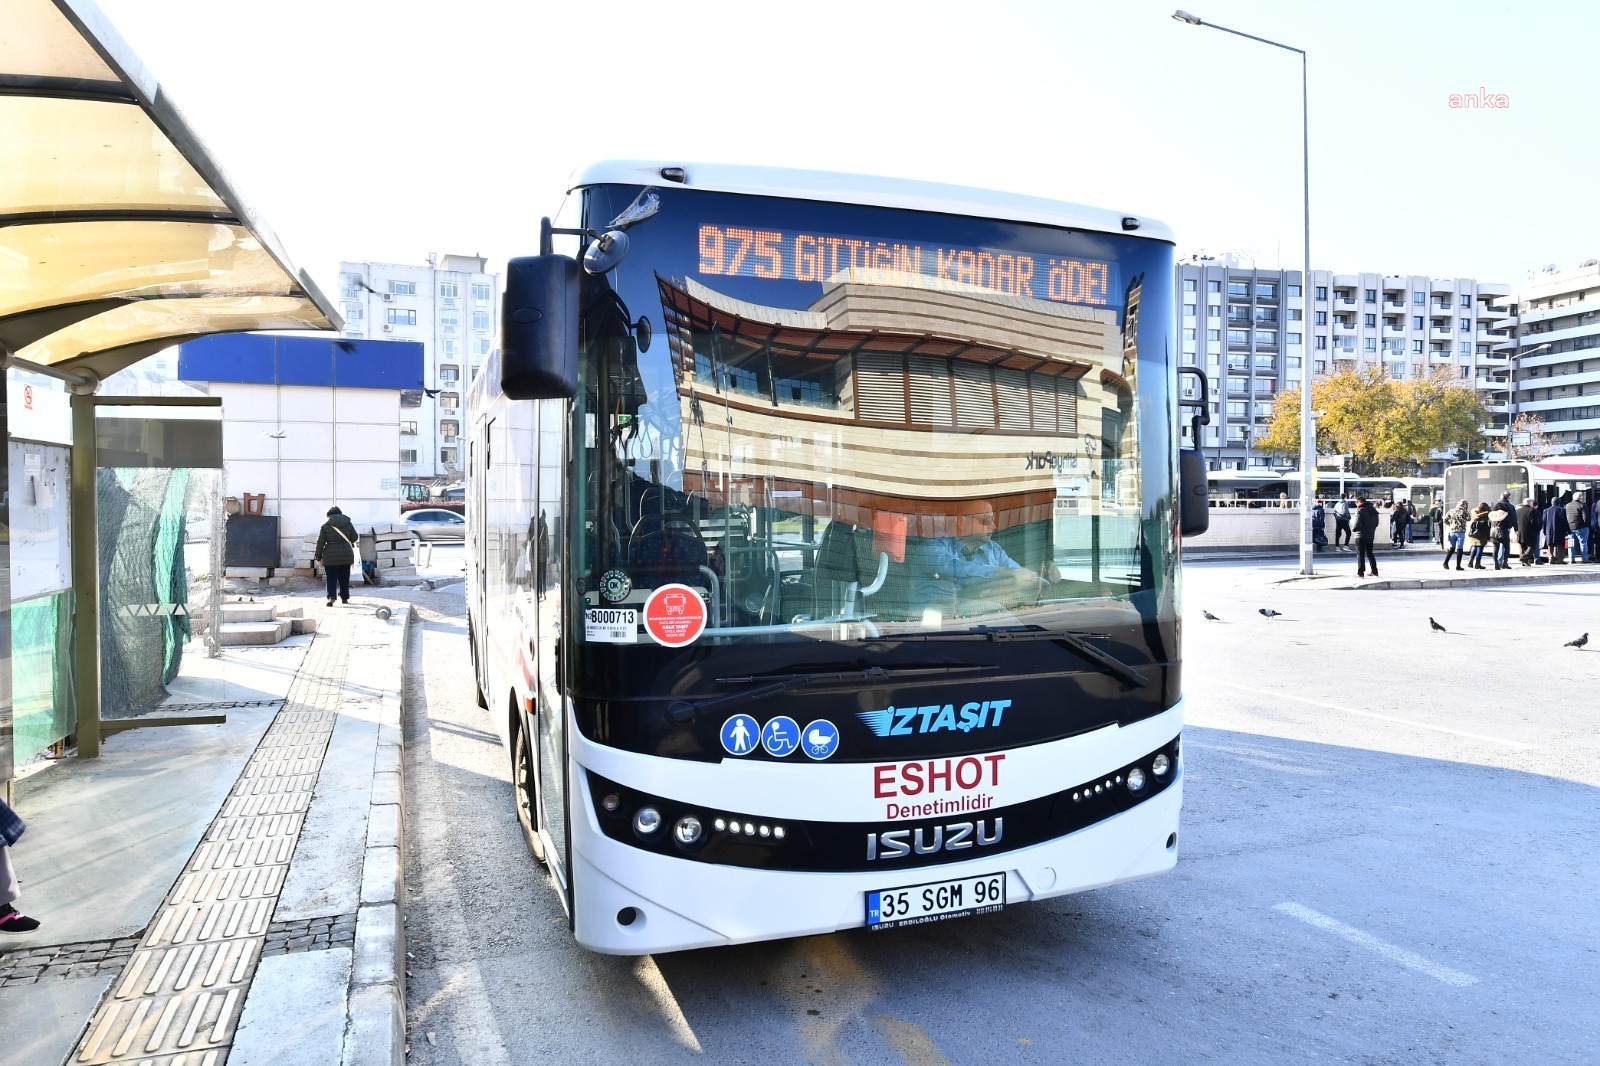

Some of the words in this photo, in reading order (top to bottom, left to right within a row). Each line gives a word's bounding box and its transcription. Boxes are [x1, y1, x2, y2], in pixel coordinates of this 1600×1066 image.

[699, 225, 782, 279] 975
[937, 248, 1034, 298] KADAR
[1049, 259, 1107, 305] ÖDE!
[610, 581, 619, 590] OK
[591, 610, 634, 624] B000713
[854, 699, 1012, 737] İZTAŞIT
[873, 754, 1006, 799] ESHOT
[886, 793, 994, 820] Denetimlidir
[866, 817, 1003, 861] ISUZU
[869, 909, 880, 918] TR
[882, 892, 909, 918] 35
[922, 883, 963, 911] SGM
[974, 879, 1000, 903] 96
